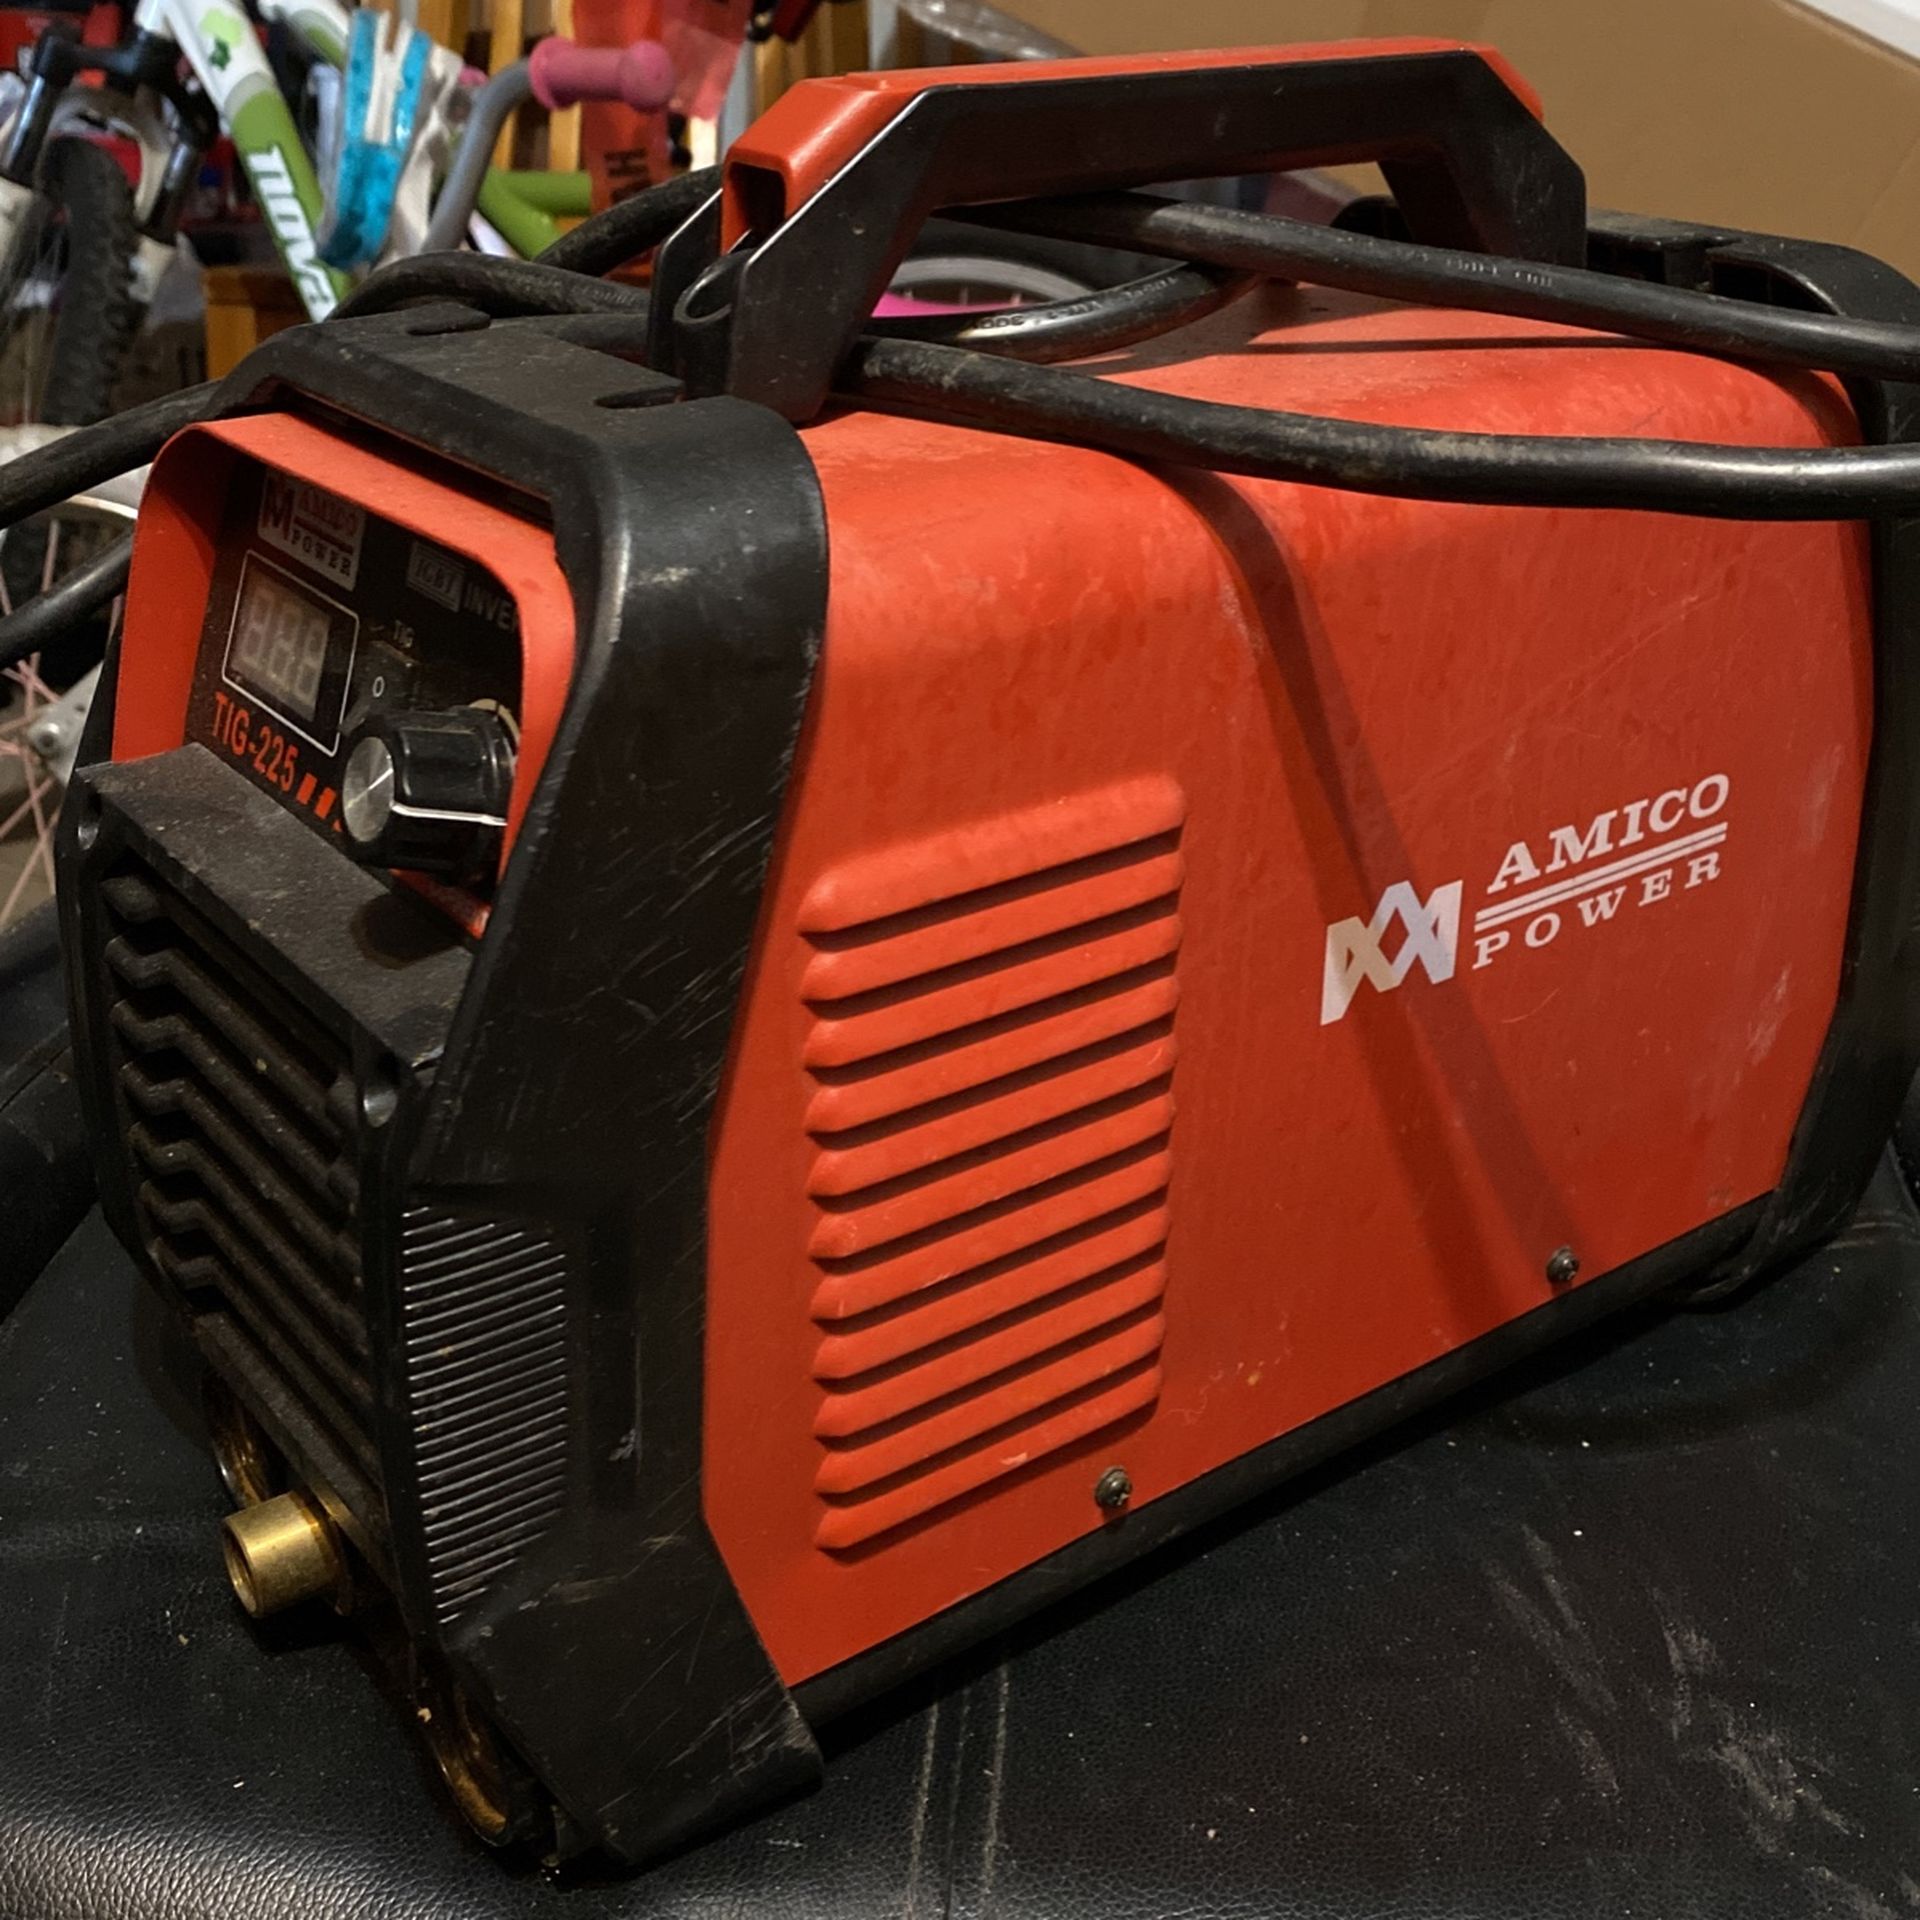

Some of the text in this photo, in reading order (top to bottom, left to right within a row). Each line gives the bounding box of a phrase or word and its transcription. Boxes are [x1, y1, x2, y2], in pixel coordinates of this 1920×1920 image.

[247, 143, 339, 324] nova
[291, 529, 352, 576] POWER
[463, 581, 518, 632] INVE
[213, 690, 299, 793] TIG-225
[1486, 773, 1729, 894] AMICO
[1471, 851, 1721, 970] POWER
